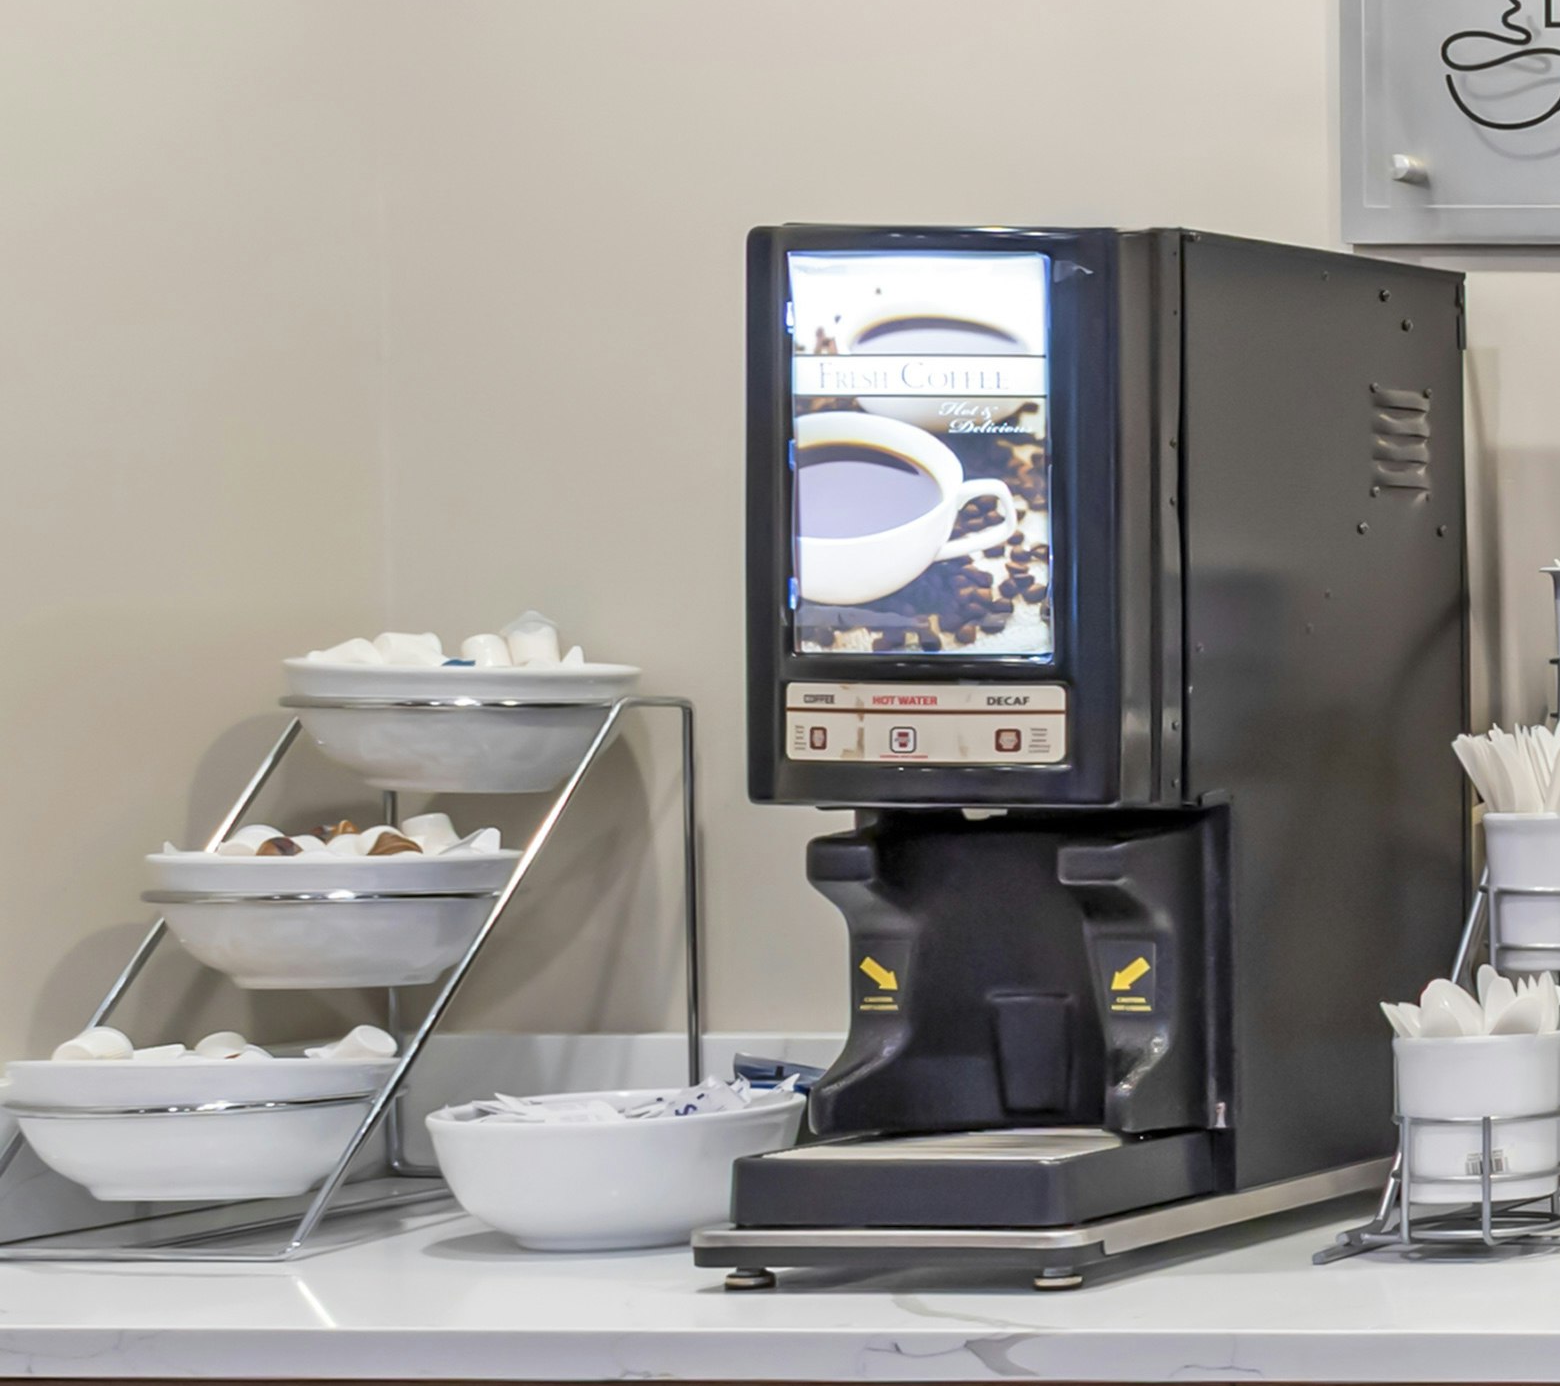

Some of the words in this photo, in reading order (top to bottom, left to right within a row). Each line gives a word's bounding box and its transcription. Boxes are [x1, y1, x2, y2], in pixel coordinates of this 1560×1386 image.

[938, 401, 977, 418] Hot
[872, 696, 896, 706] HOT
[897, 696, 938, 706] WATER
[986, 696, 1031, 706] DECAF
